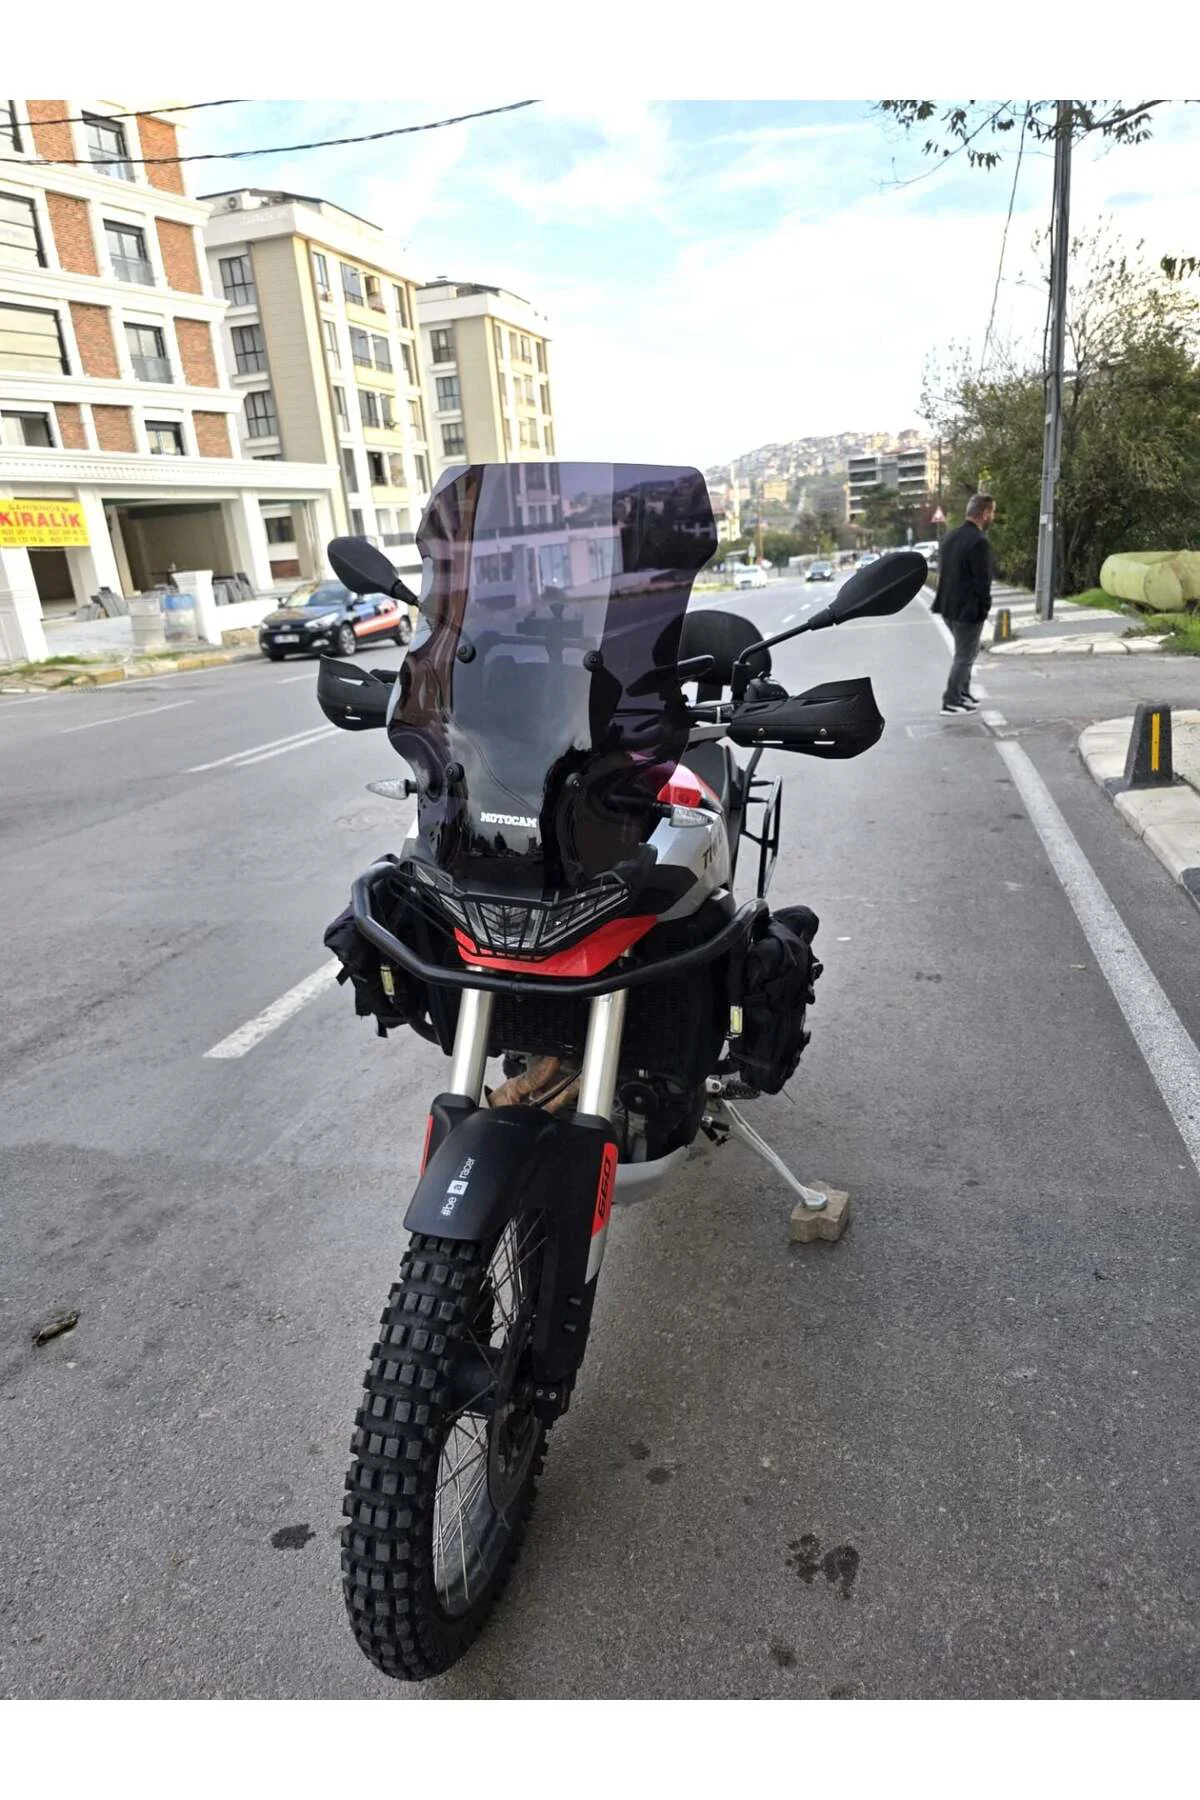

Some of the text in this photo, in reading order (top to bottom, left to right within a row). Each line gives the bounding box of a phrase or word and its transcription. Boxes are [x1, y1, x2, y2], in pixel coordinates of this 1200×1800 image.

[480, 811, 537, 828] MOTOCAM
[440, 1196, 457, 1216] #be
[459, 1156, 476, 1178] racer
[598, 1154, 611, 1217] 660
